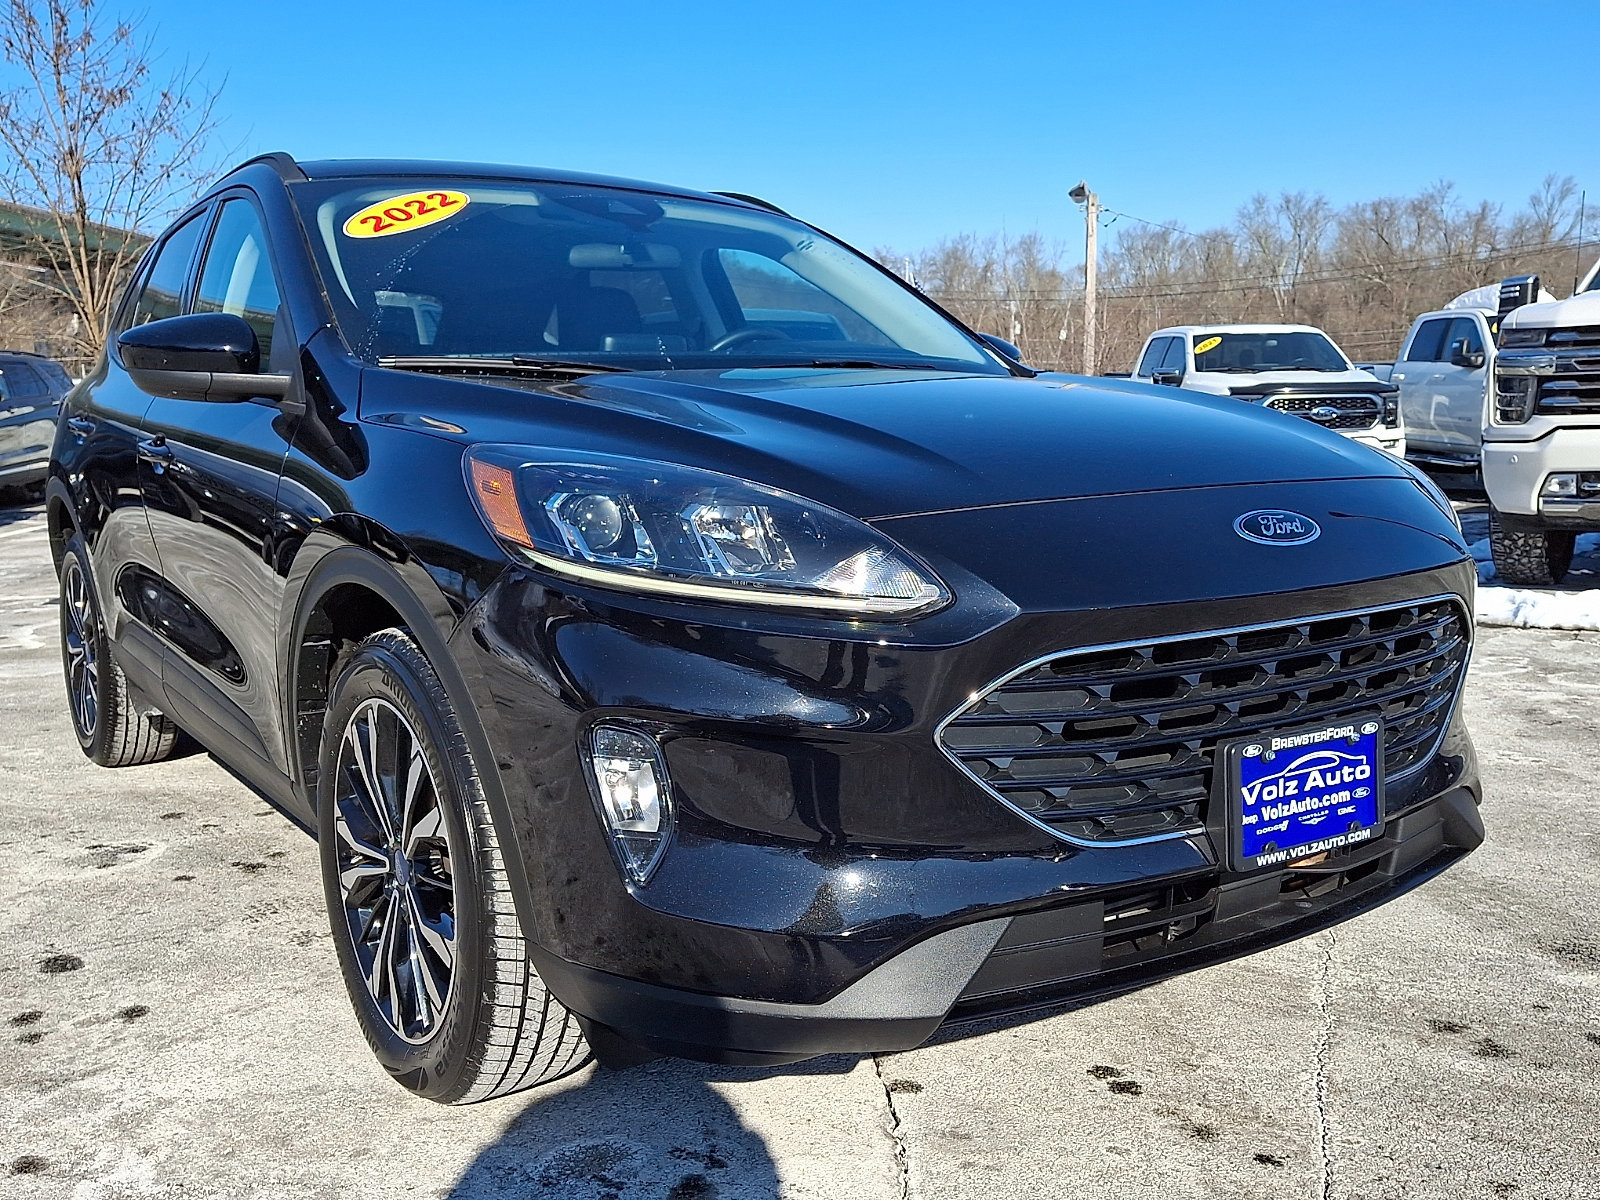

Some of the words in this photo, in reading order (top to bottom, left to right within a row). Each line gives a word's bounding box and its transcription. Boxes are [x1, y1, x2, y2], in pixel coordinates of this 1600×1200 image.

[360, 192, 459, 233] 2022
[1258, 514, 1305, 536] Ford
[1240, 778, 1299, 806] Volz
[1304, 764, 1371, 792] Auto
[1242, 814, 1258, 826] Jeep
[1261, 790, 1351, 821] VolzAuto.com
[1337, 805, 1356, 815] GMC
[1257, 828, 1371, 867] WWW.VOLZAUTO.COM
